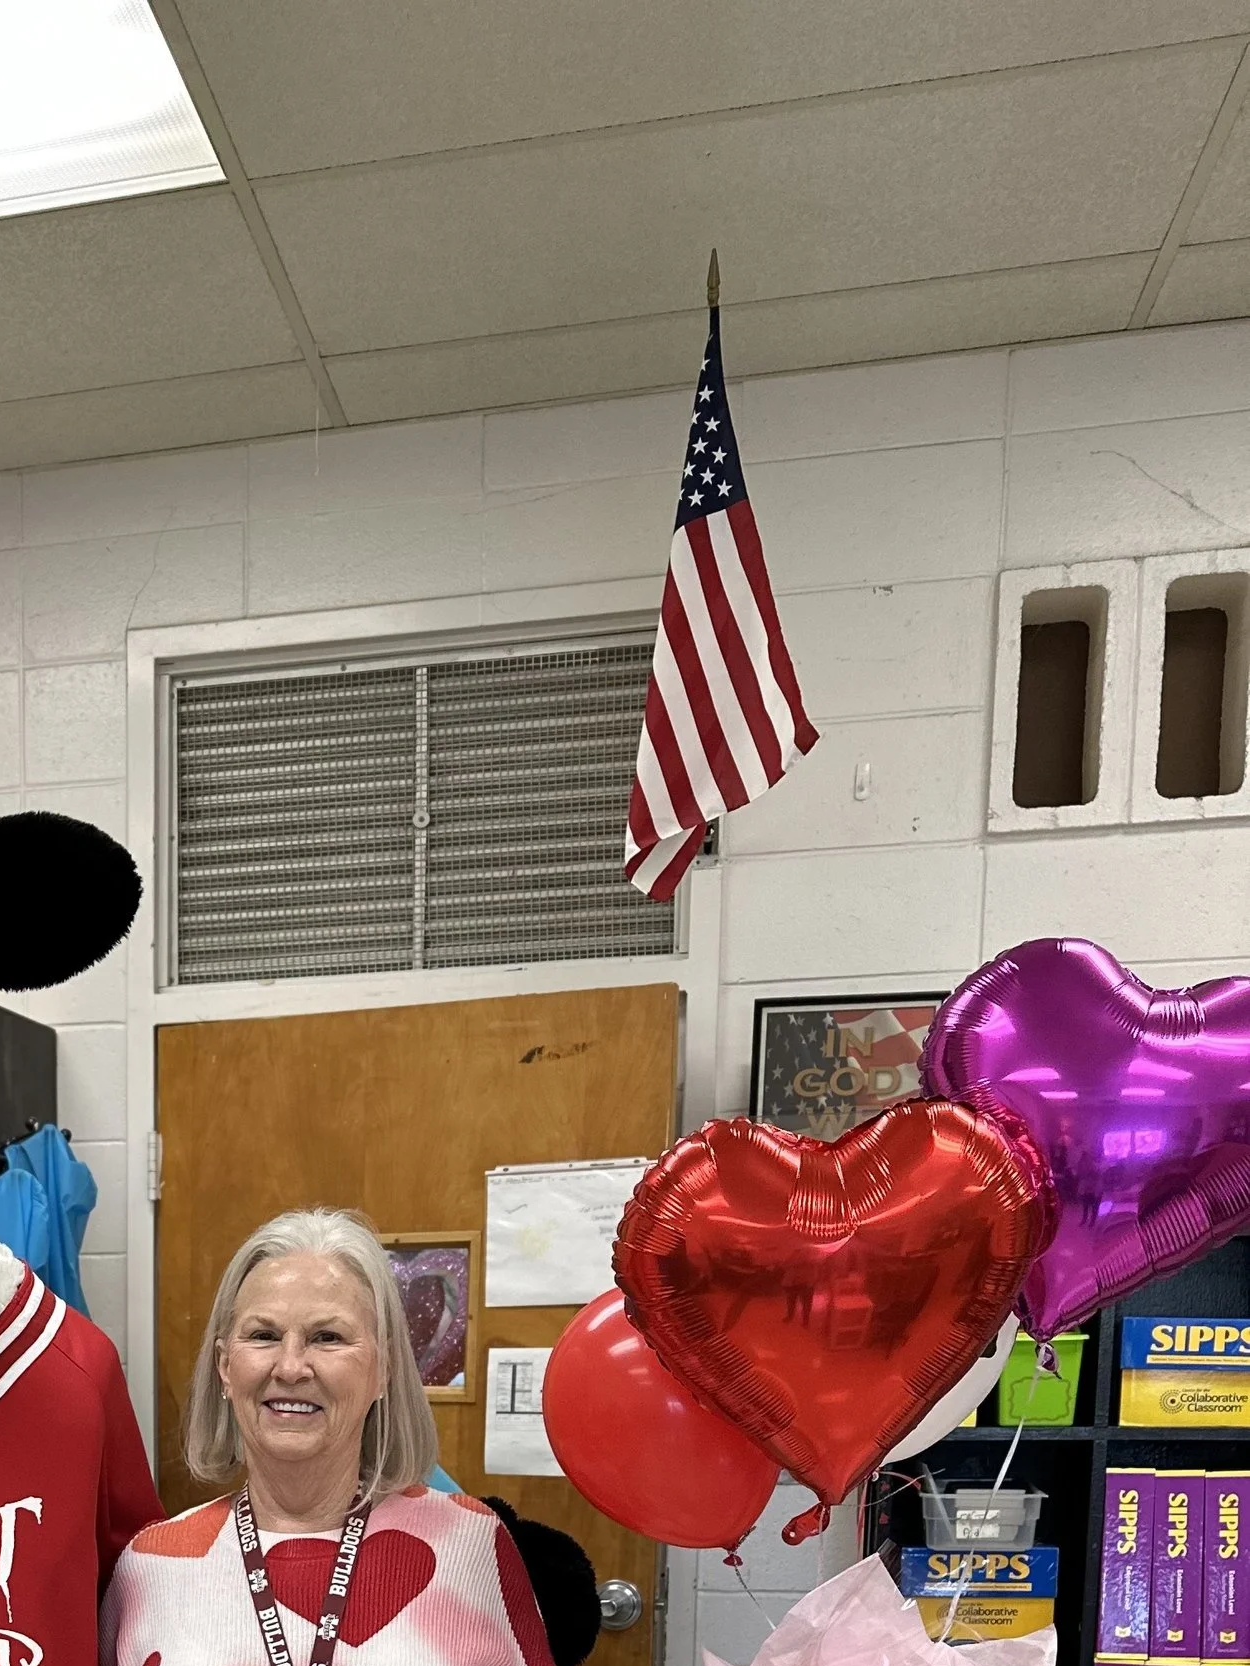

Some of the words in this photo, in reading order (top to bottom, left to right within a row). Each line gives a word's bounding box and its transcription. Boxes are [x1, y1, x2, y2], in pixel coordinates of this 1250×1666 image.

[823, 1027, 875, 1058] IN
[793, 1066, 902, 1098] GOD
[1180, 1392, 1249, 1403] Collaborative
[1187, 1403, 1242, 1412] Classroom
[1117, 1489, 1139, 1555] SIPPS
[1167, 1492, 1188, 1559] SIPPS
[1218, 1493, 1239, 1559] SIPPS
[329, 1517, 365, 1597] BULLDOGS
[927, 1553, 1031, 1580] SIPPS
[1228, 1570, 1236, 1598] Extension
[956, 1607, 1019, 1616] Collaborative
[961, 1616, 1013, 1626] Classroom
